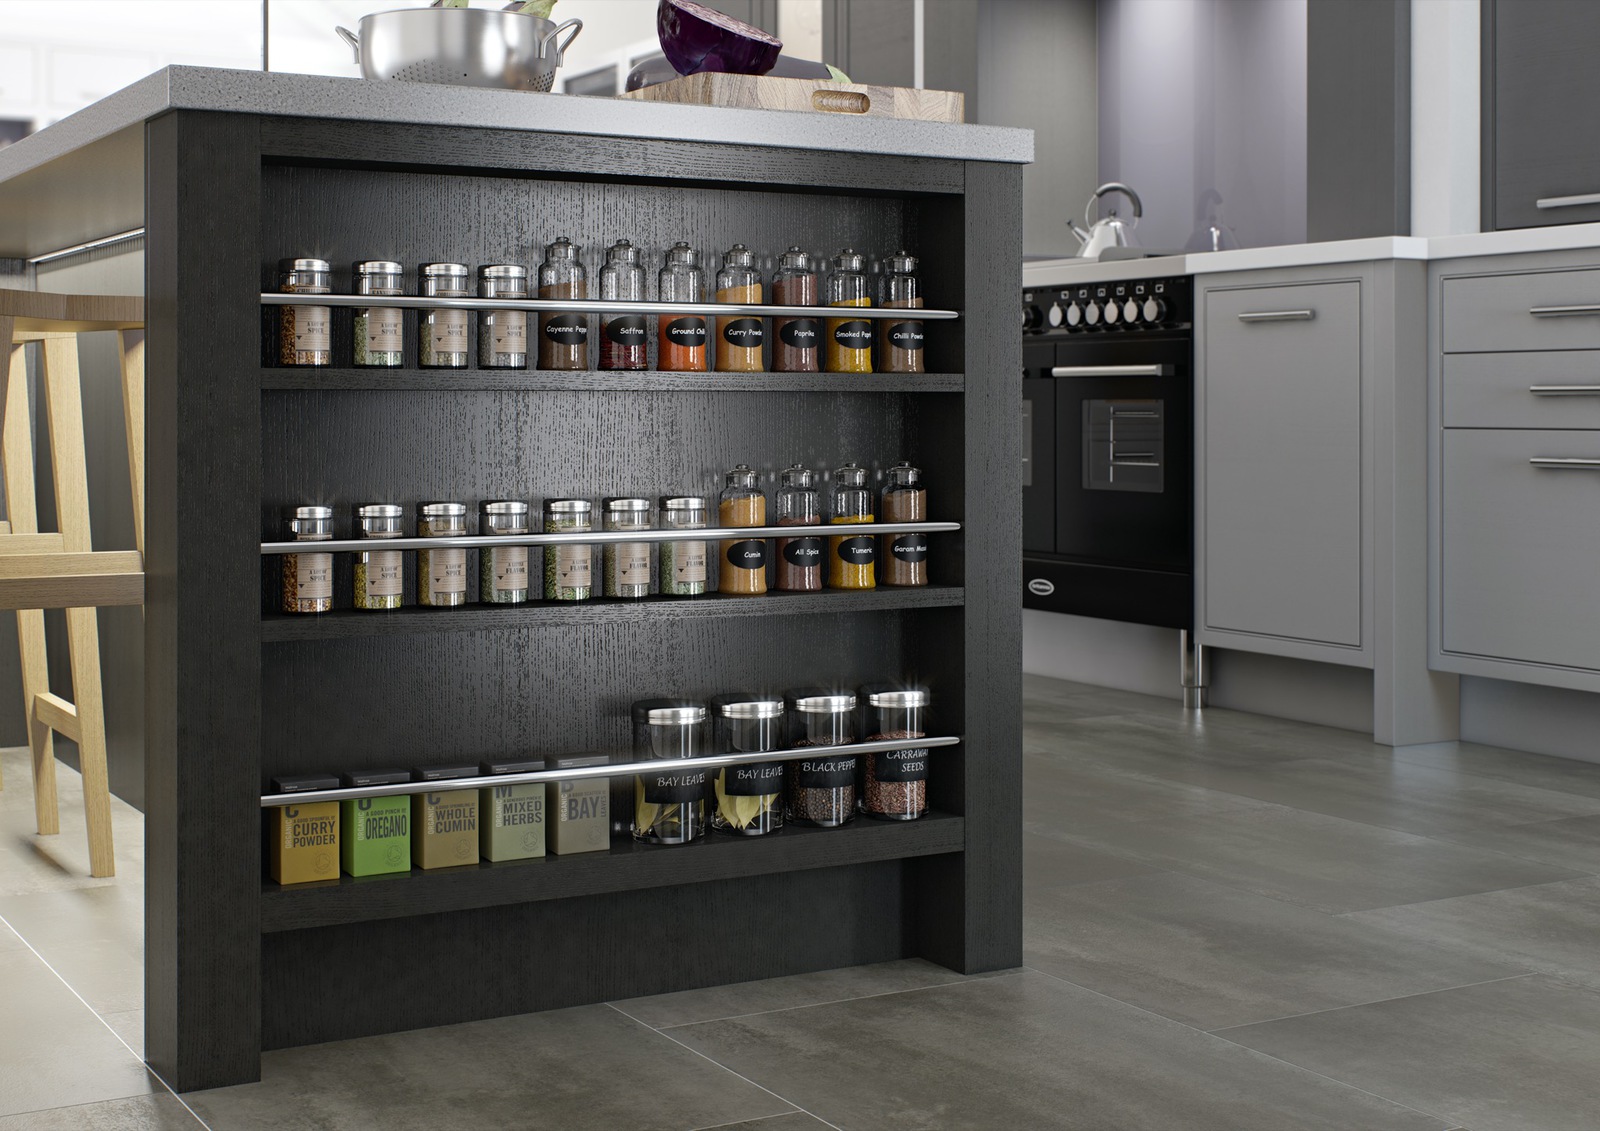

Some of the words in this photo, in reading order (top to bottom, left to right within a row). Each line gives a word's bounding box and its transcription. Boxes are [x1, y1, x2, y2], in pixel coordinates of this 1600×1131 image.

[546, 325, 574, 334] Cayenne
[728, 329, 747, 337] Curry
[801, 762, 836, 772] BLACK
[902, 760, 924, 772] SEEDS
[656, 776, 680, 786] BAY
[736, 769, 760, 780] BAY
[503, 800, 542, 814] MIXED
[568, 796, 600, 820] BAY
[436, 808, 476, 820] WHOLE
[503, 812, 542, 826] HERBS
[294, 821, 336, 836] CURRY
[366, 814, 406, 840] OREGANO
[436, 819, 476, 834] CUMIN
[294, 834, 336, 848] POWDER
